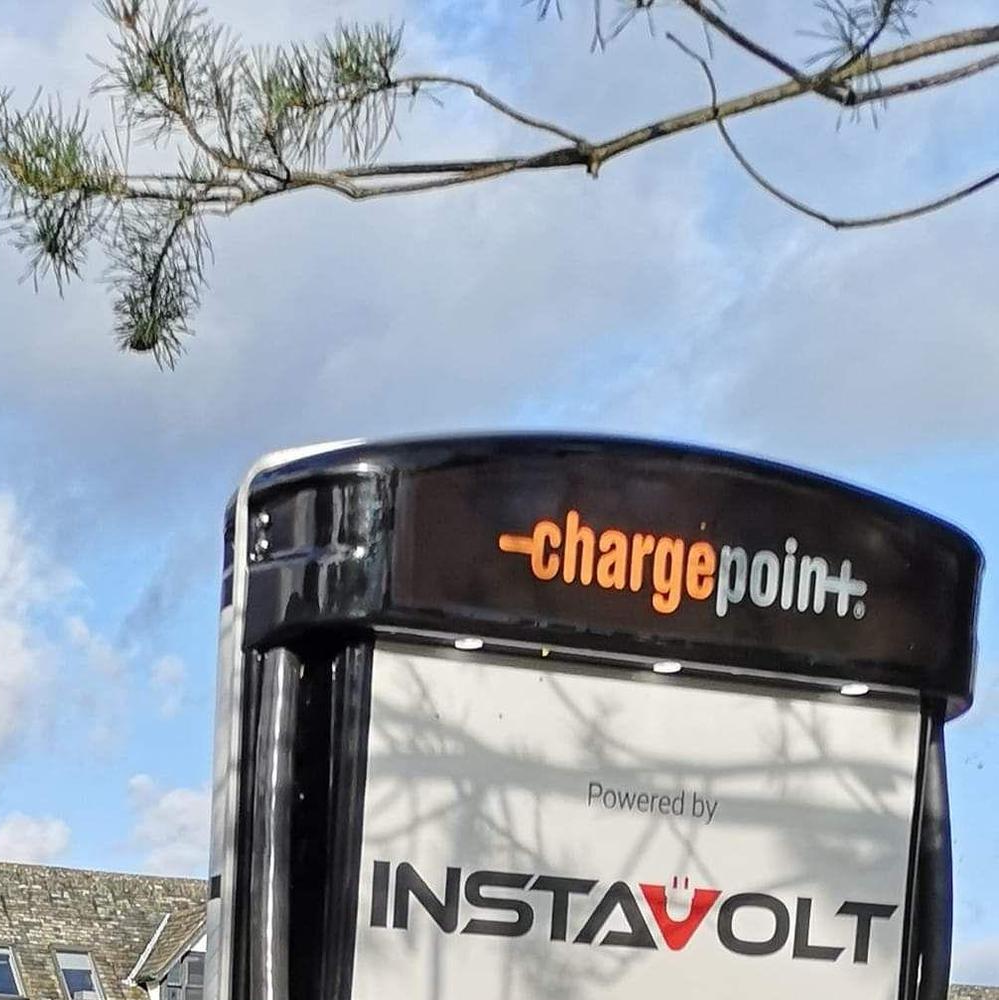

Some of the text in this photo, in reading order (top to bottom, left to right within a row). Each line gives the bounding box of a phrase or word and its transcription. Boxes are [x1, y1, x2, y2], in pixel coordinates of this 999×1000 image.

[500, 508, 869, 618] chargepoint
[587, 780, 719, 826] Powered by
[369, 860, 899, 965] INSTAVOLT
